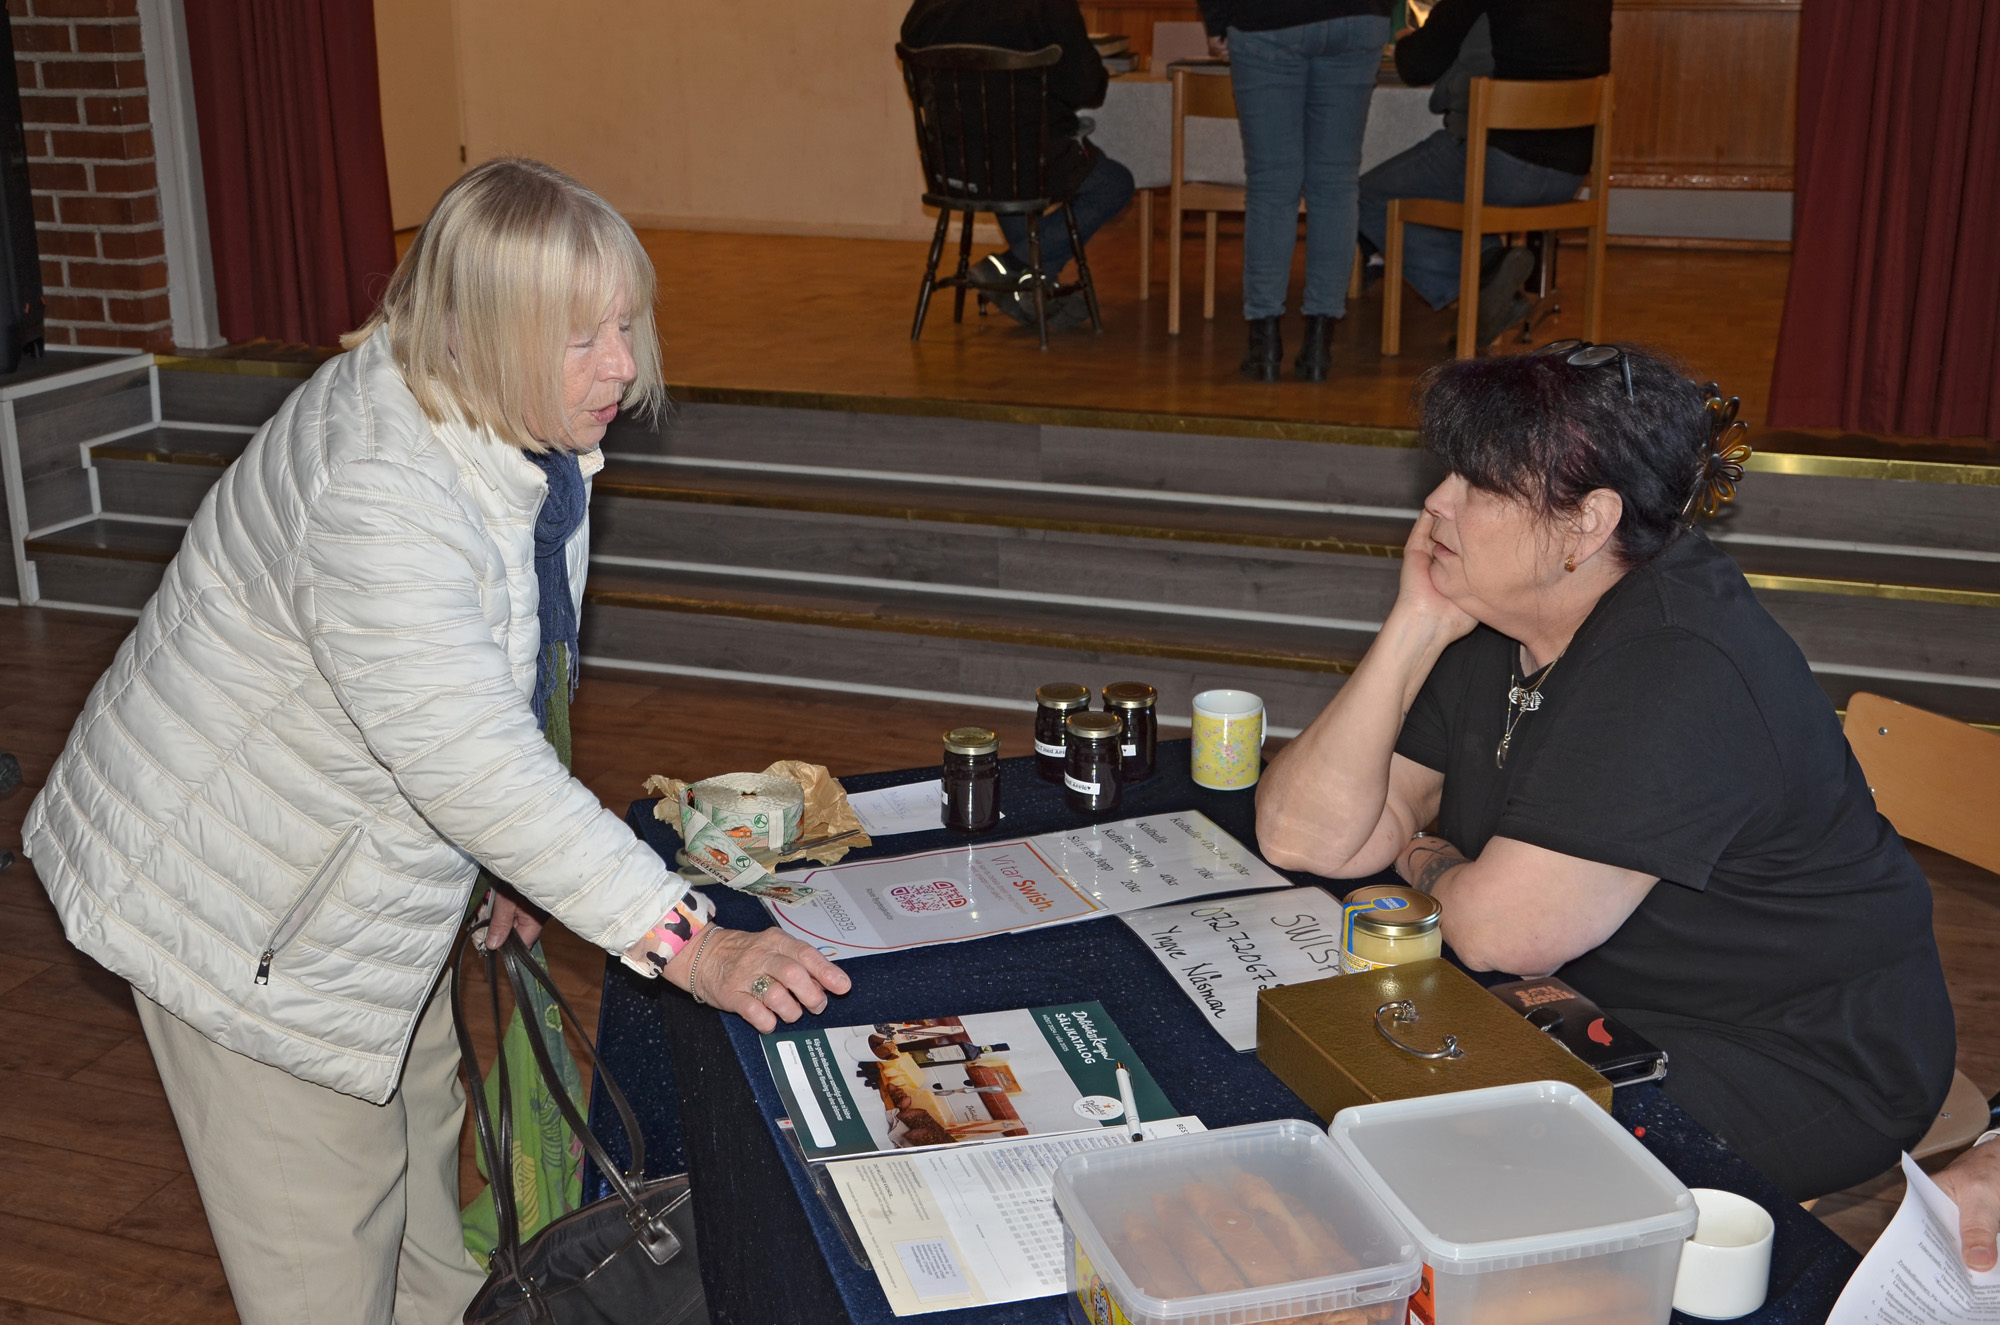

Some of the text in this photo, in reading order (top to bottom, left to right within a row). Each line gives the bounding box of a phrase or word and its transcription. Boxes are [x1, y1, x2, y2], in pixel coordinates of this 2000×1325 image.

[1102, 829, 1178, 886] Kaffe med dopp 40kr
[1197, 867, 1214, 880] 70kr
[992, 854, 1053, 911] Vi tar Swish.
[1094, 859, 1114, 871] dopp
[1120, 880, 1141, 893] 20kr
[1191, 907, 1240, 932] 072
[1151, 925, 1187, 960] Yngve
[1055, 1013, 1096, 1064] SÄLJKATALOG
